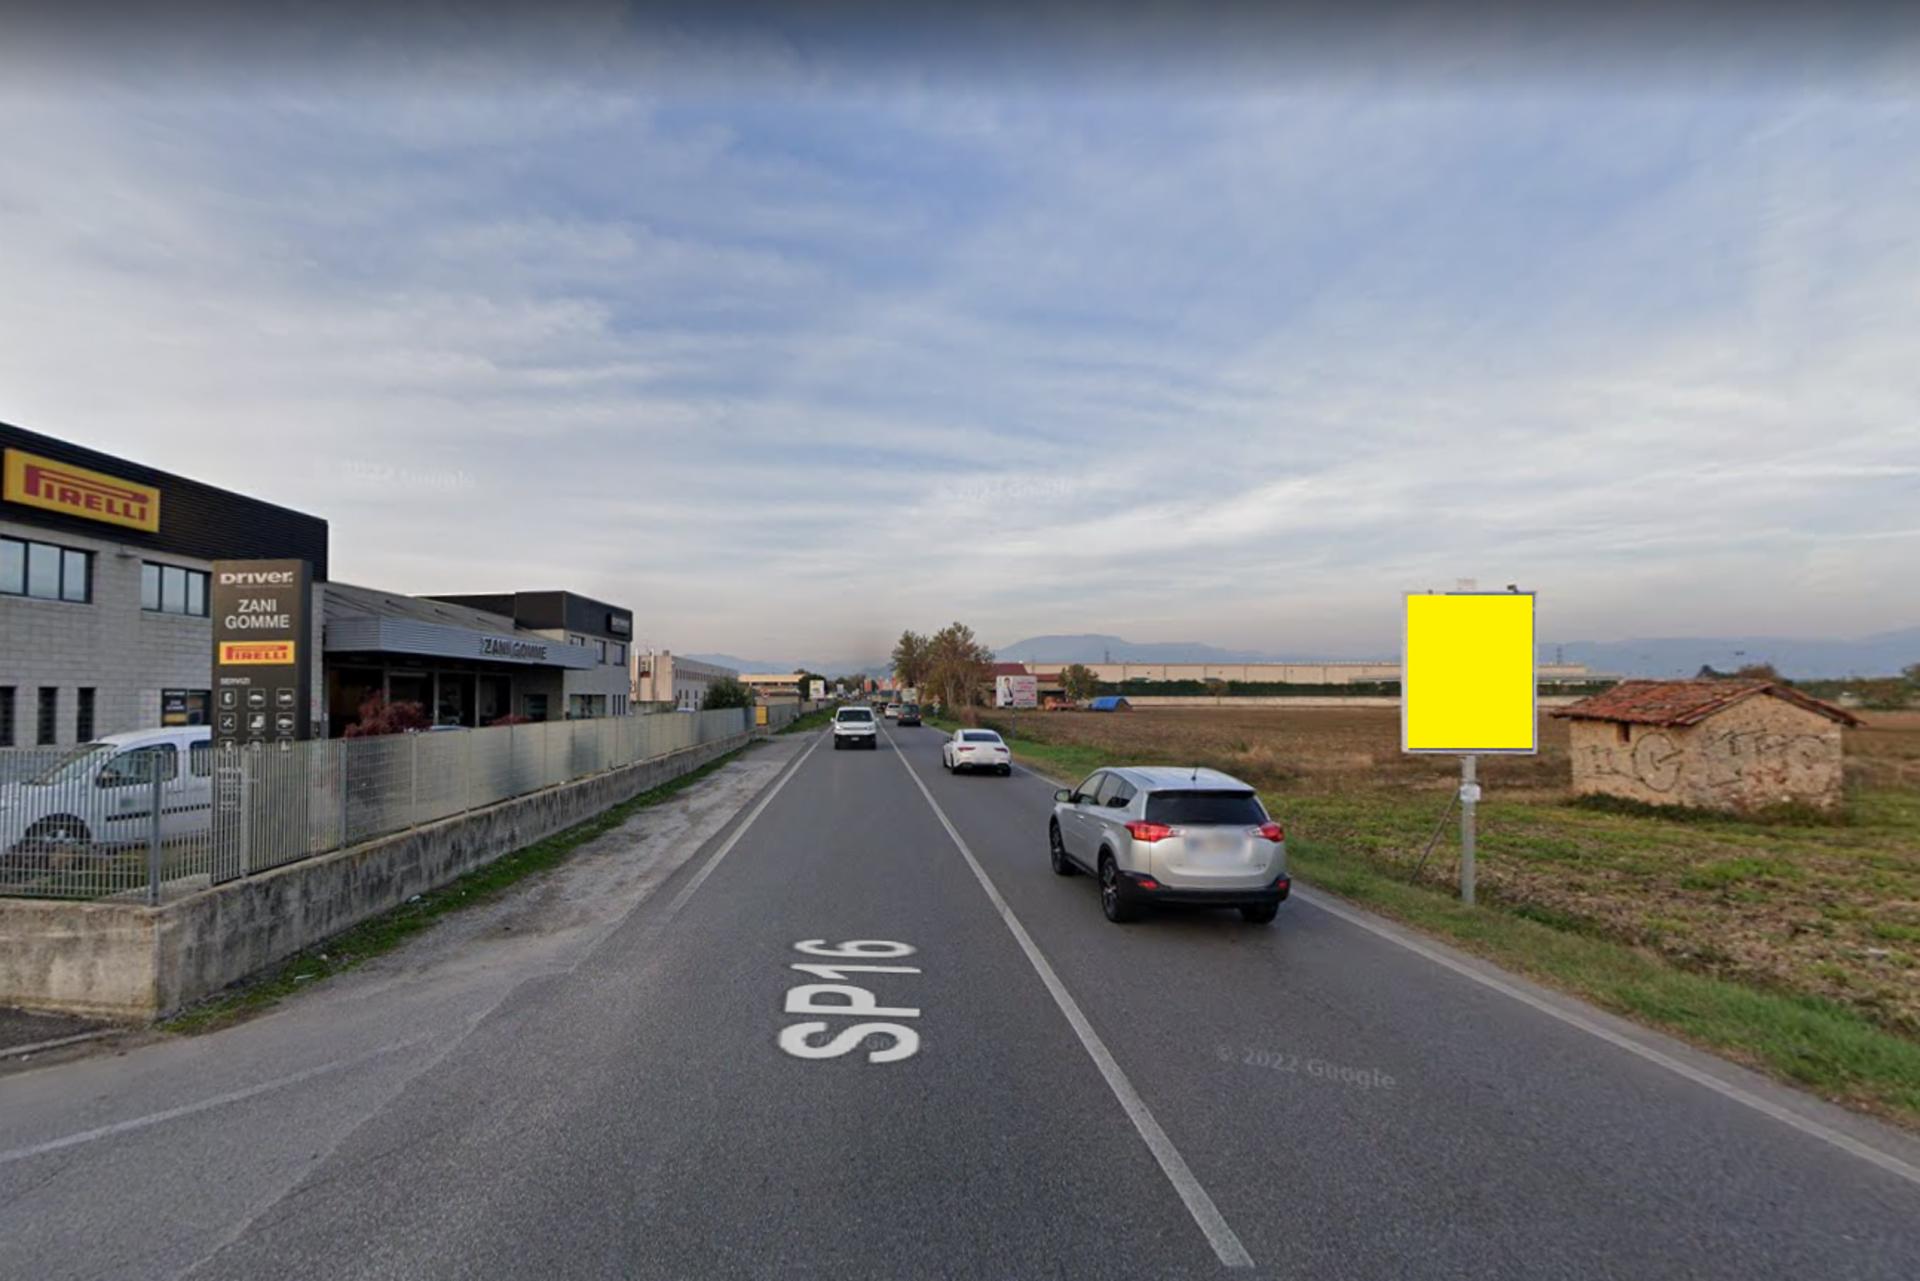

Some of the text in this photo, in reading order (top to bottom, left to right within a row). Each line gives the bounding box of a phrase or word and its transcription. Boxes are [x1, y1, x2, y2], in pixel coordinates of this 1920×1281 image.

[24, 464, 149, 522] PIRELLI
[238, 599, 277, 613] ZANI
[225, 614, 290, 630] GOMME
[226, 645, 288, 660] PIRELLI
[779, 939, 921, 1063] SP16
